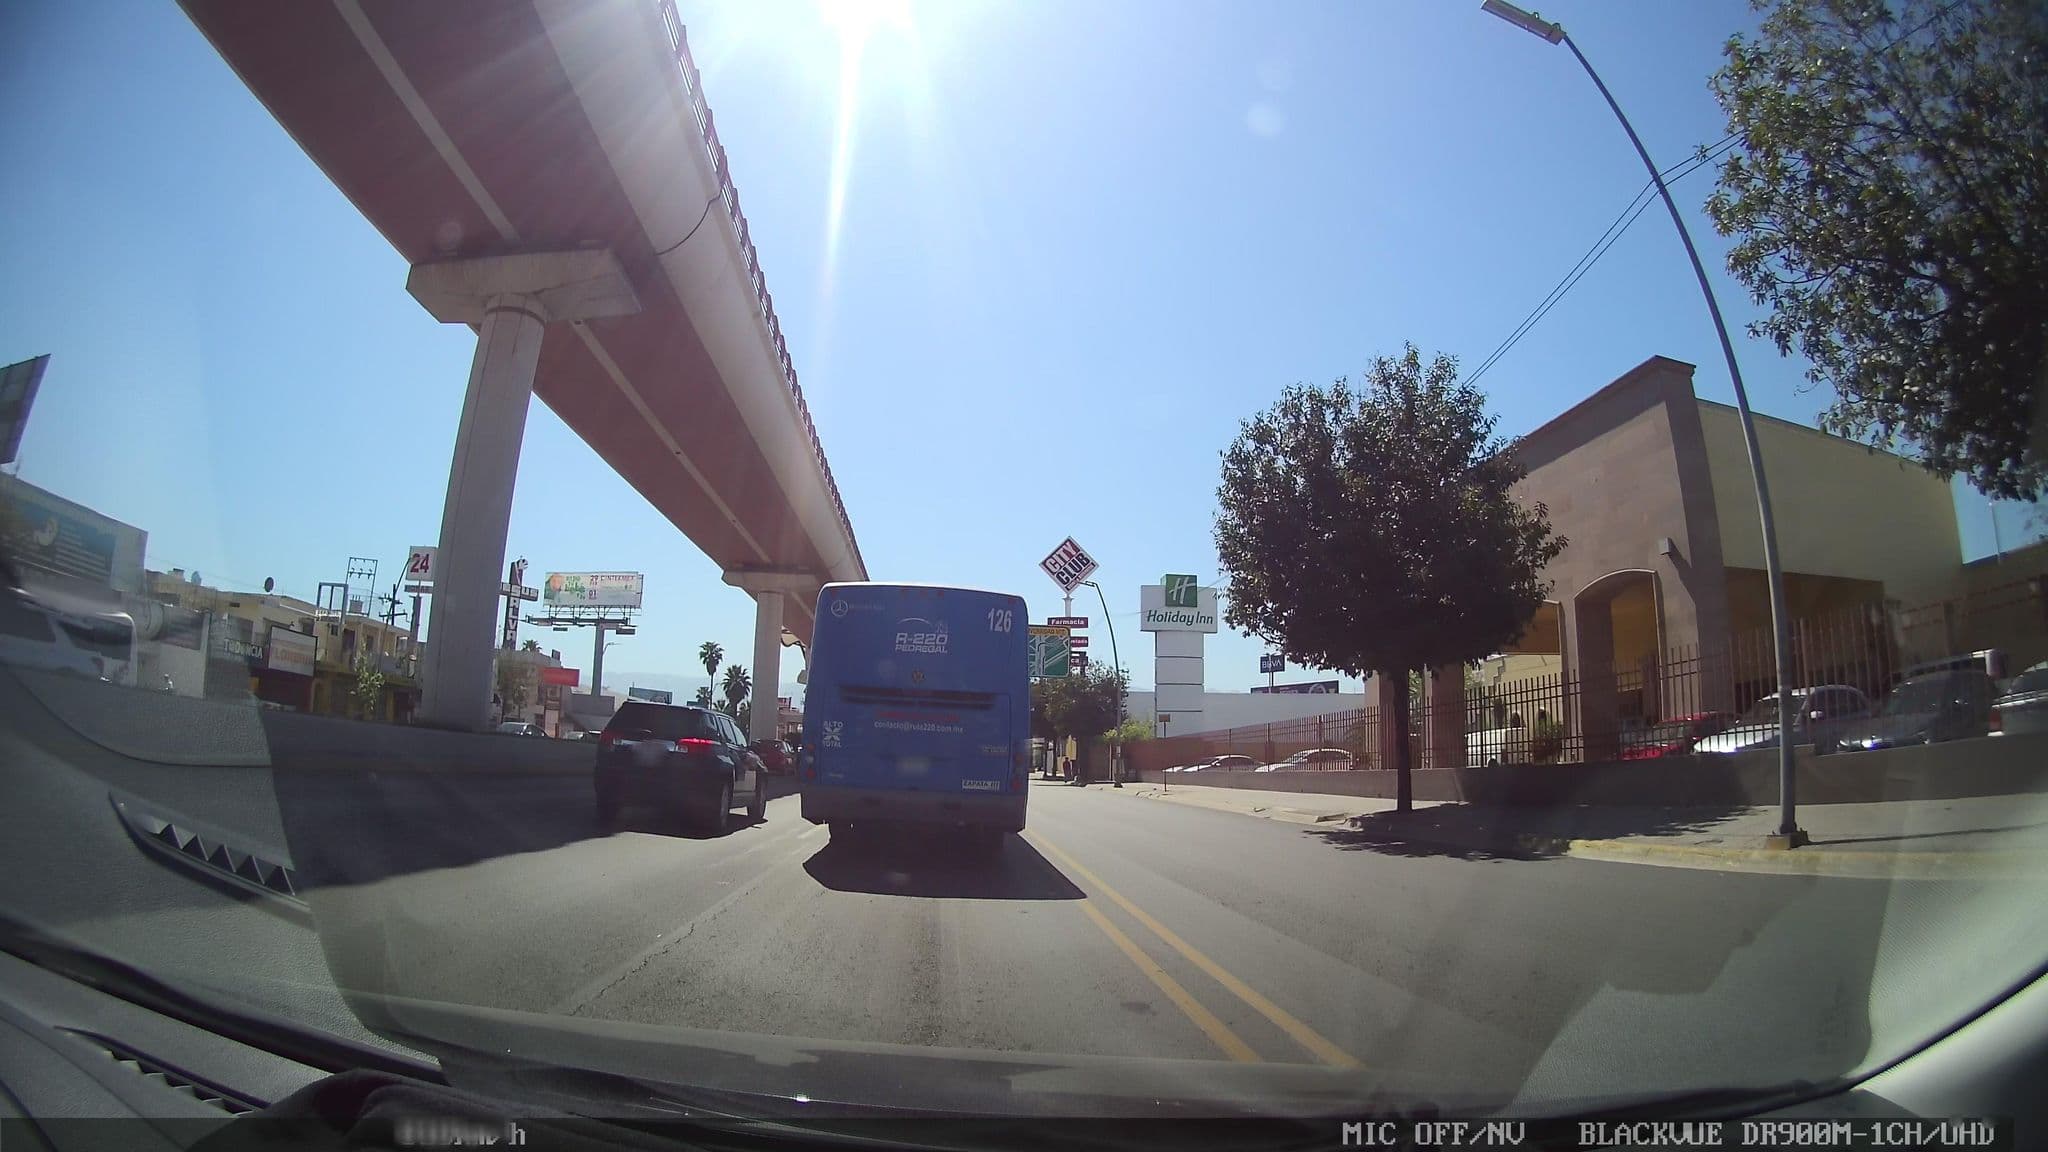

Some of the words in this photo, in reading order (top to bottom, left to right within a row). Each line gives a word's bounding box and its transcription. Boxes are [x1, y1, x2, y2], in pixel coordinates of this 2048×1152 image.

[410, 553, 430, 574] 24
[1044, 540, 1077, 573] CITY
[1055, 552, 1091, 586] CLUB
[987, 608, 1012, 633] 126
[1051, 618, 1084, 626] Farmacia
[1147, 609, 1195, 626] Holiday
[1196, 611, 1214, 625] Inn
[895, 632, 948, 645] R-220
[895, 644, 948, 655] PEDREGAL
[1261, 659, 1282, 669] BBVA
